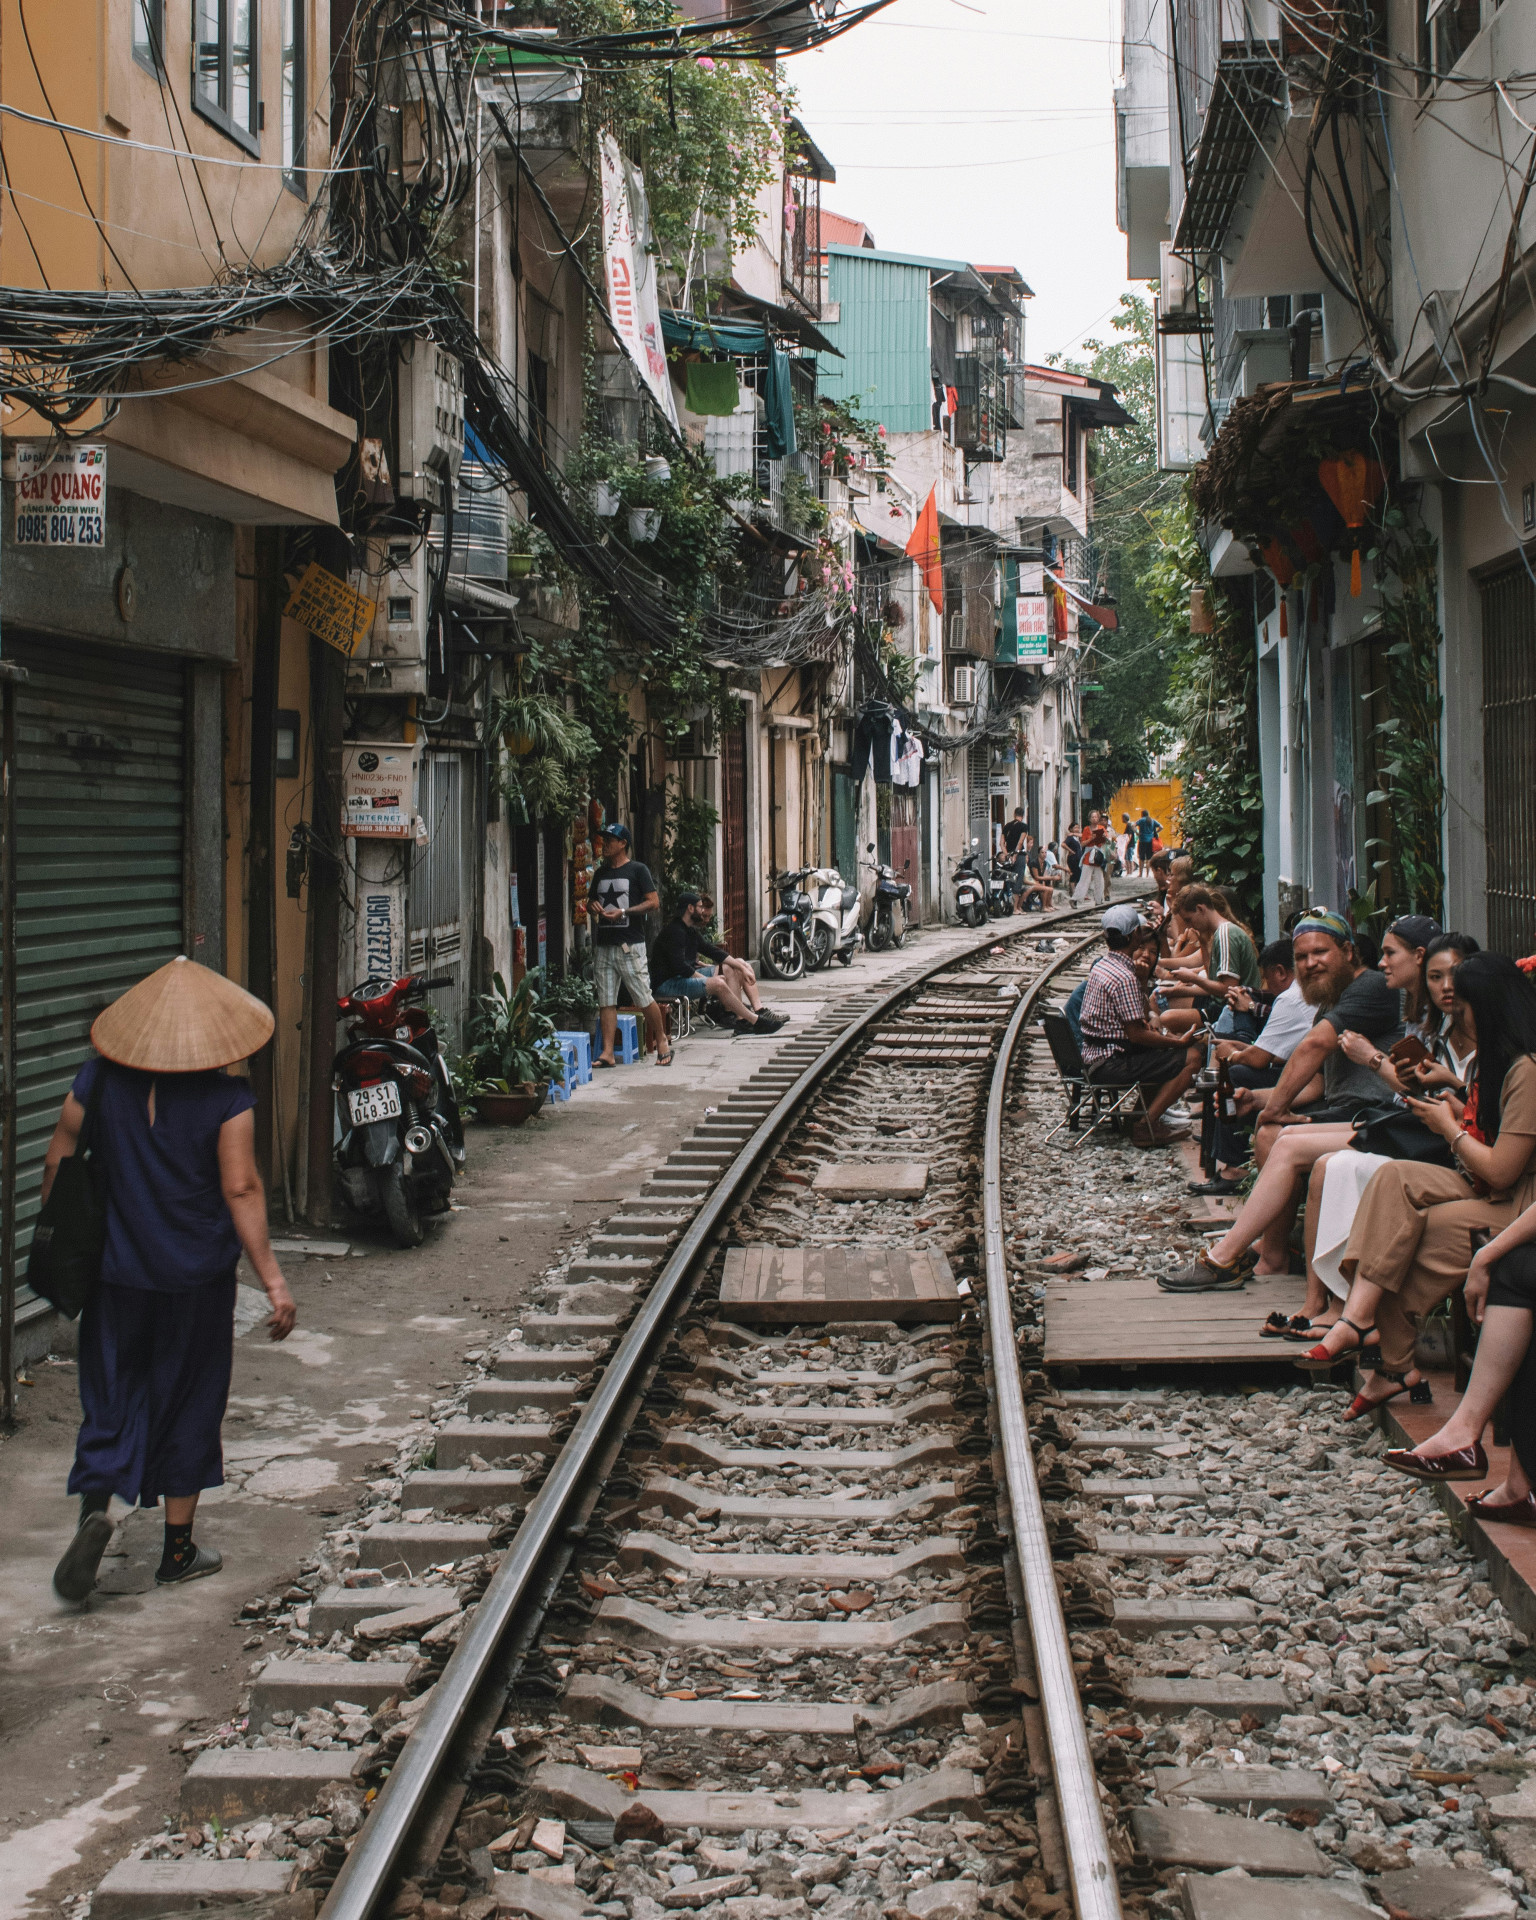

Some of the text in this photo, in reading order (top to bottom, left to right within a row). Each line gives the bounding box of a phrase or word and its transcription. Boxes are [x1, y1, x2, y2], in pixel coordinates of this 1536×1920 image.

[80, 450, 103, 466] FPT
[51, 472, 101, 505] QUANG
[45, 506, 78, 514] MODEM
[17, 514, 102, 543] 0985 804 253
[355, 1100, 397, 1122] 048.30
